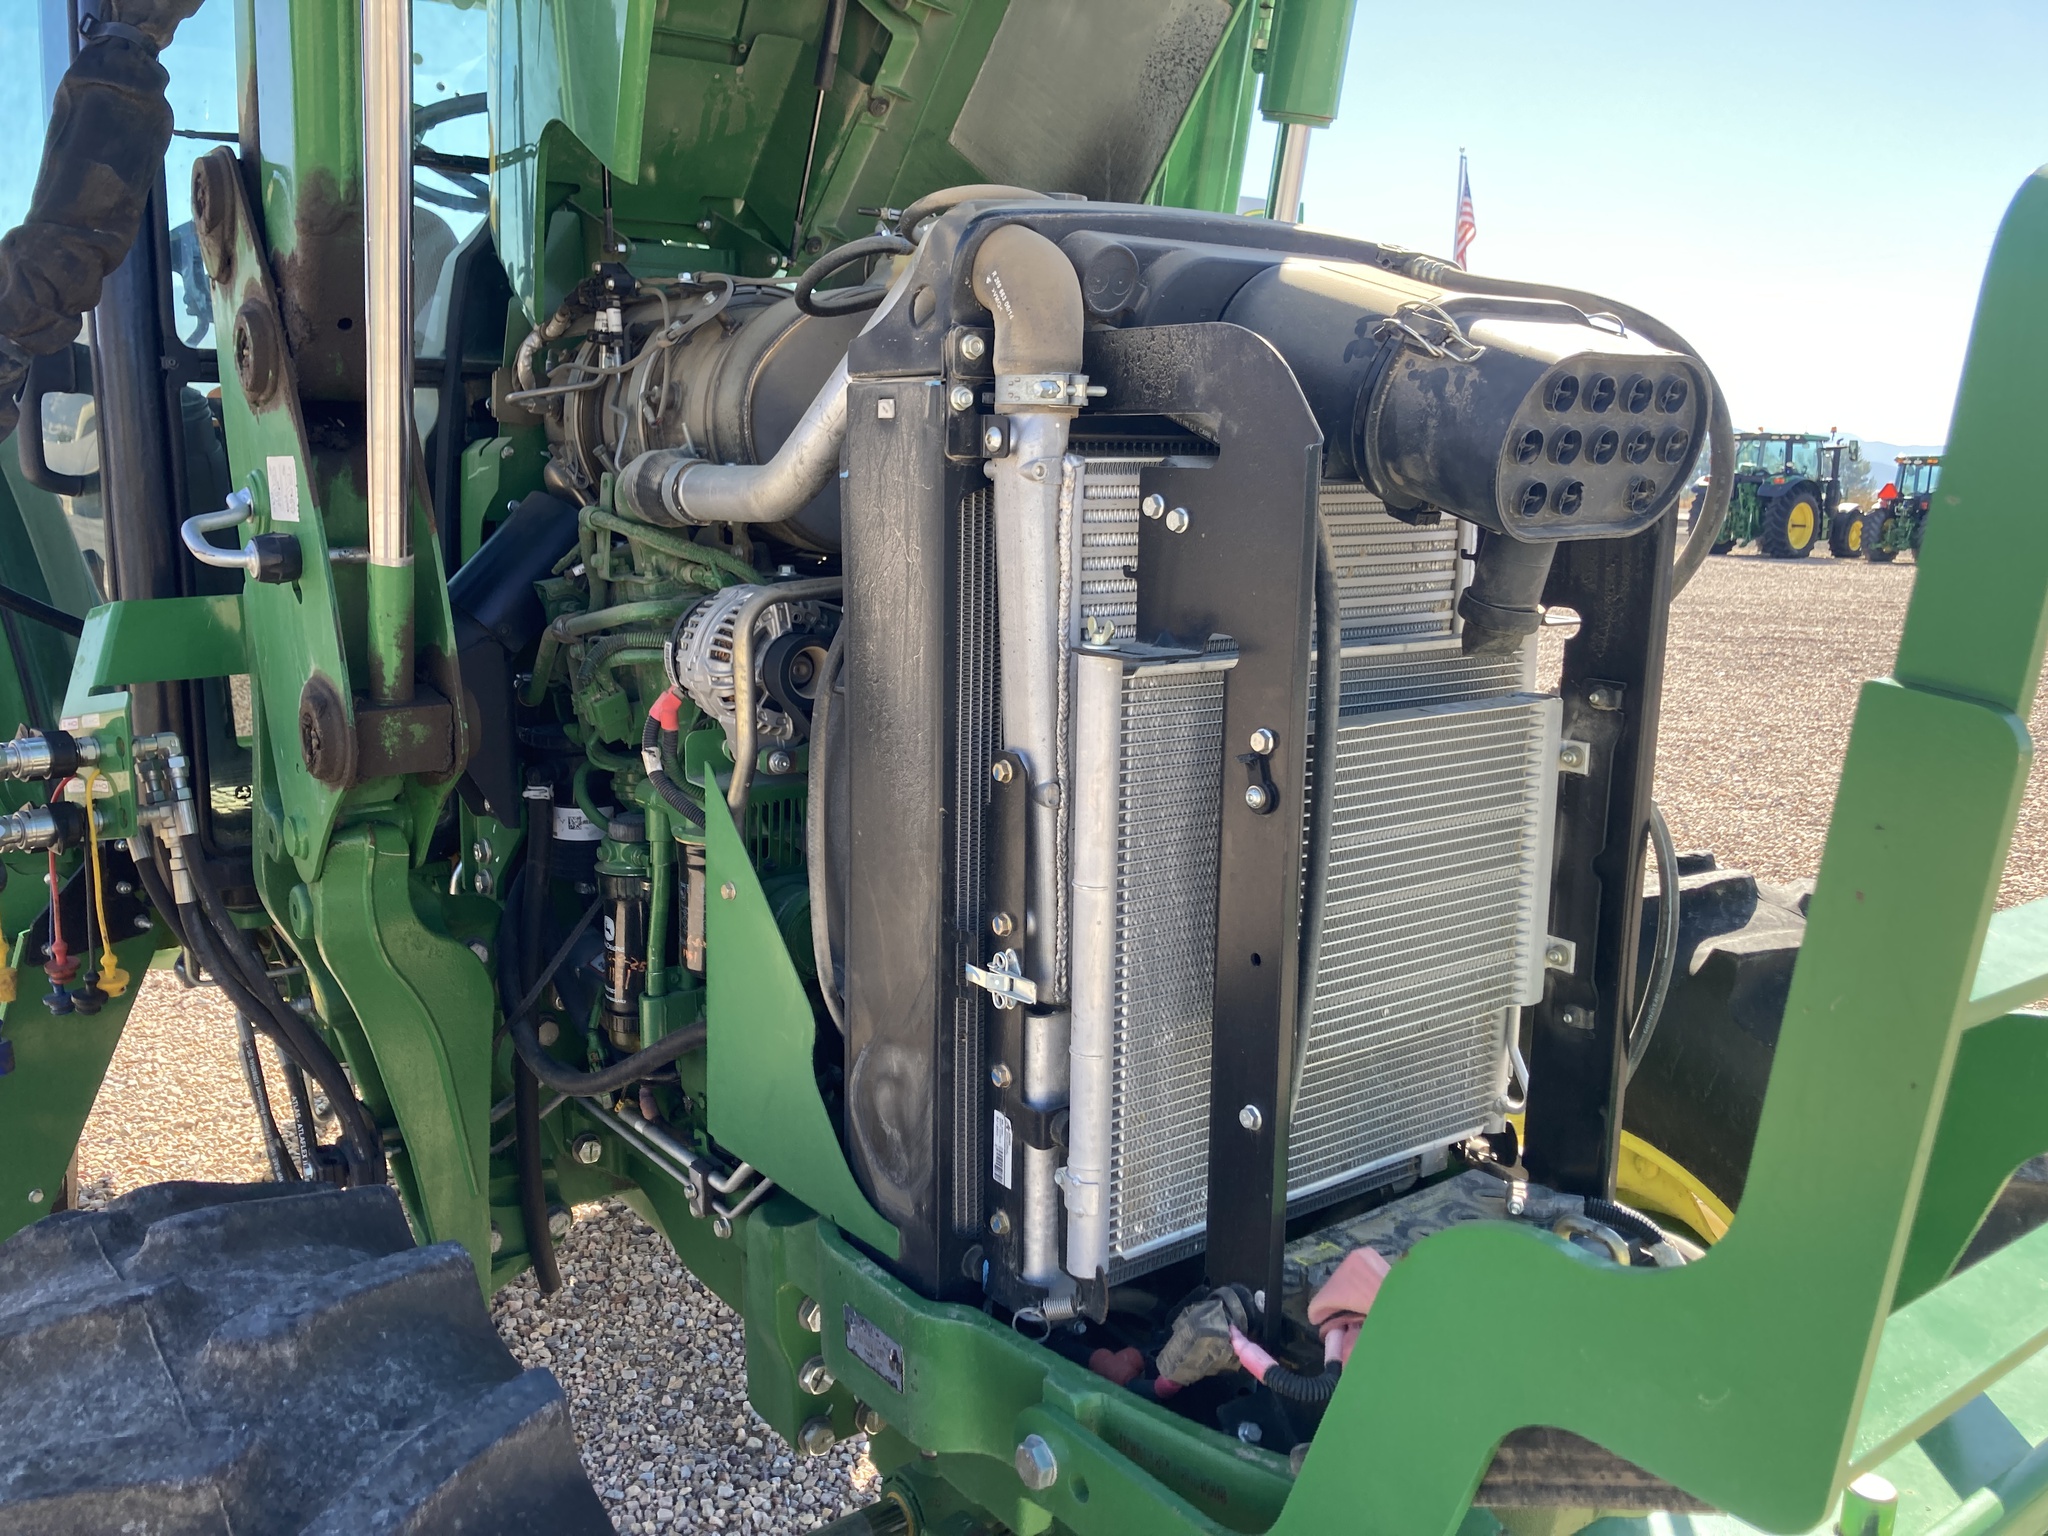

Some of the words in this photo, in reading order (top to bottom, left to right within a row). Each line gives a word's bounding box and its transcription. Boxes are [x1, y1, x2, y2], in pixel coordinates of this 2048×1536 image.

[256, 1086, 266, 1114] Resistant
[292, 1096, 301, 1119] ATLAS
[297, 1123, 308, 1159] ATLAFLEX
